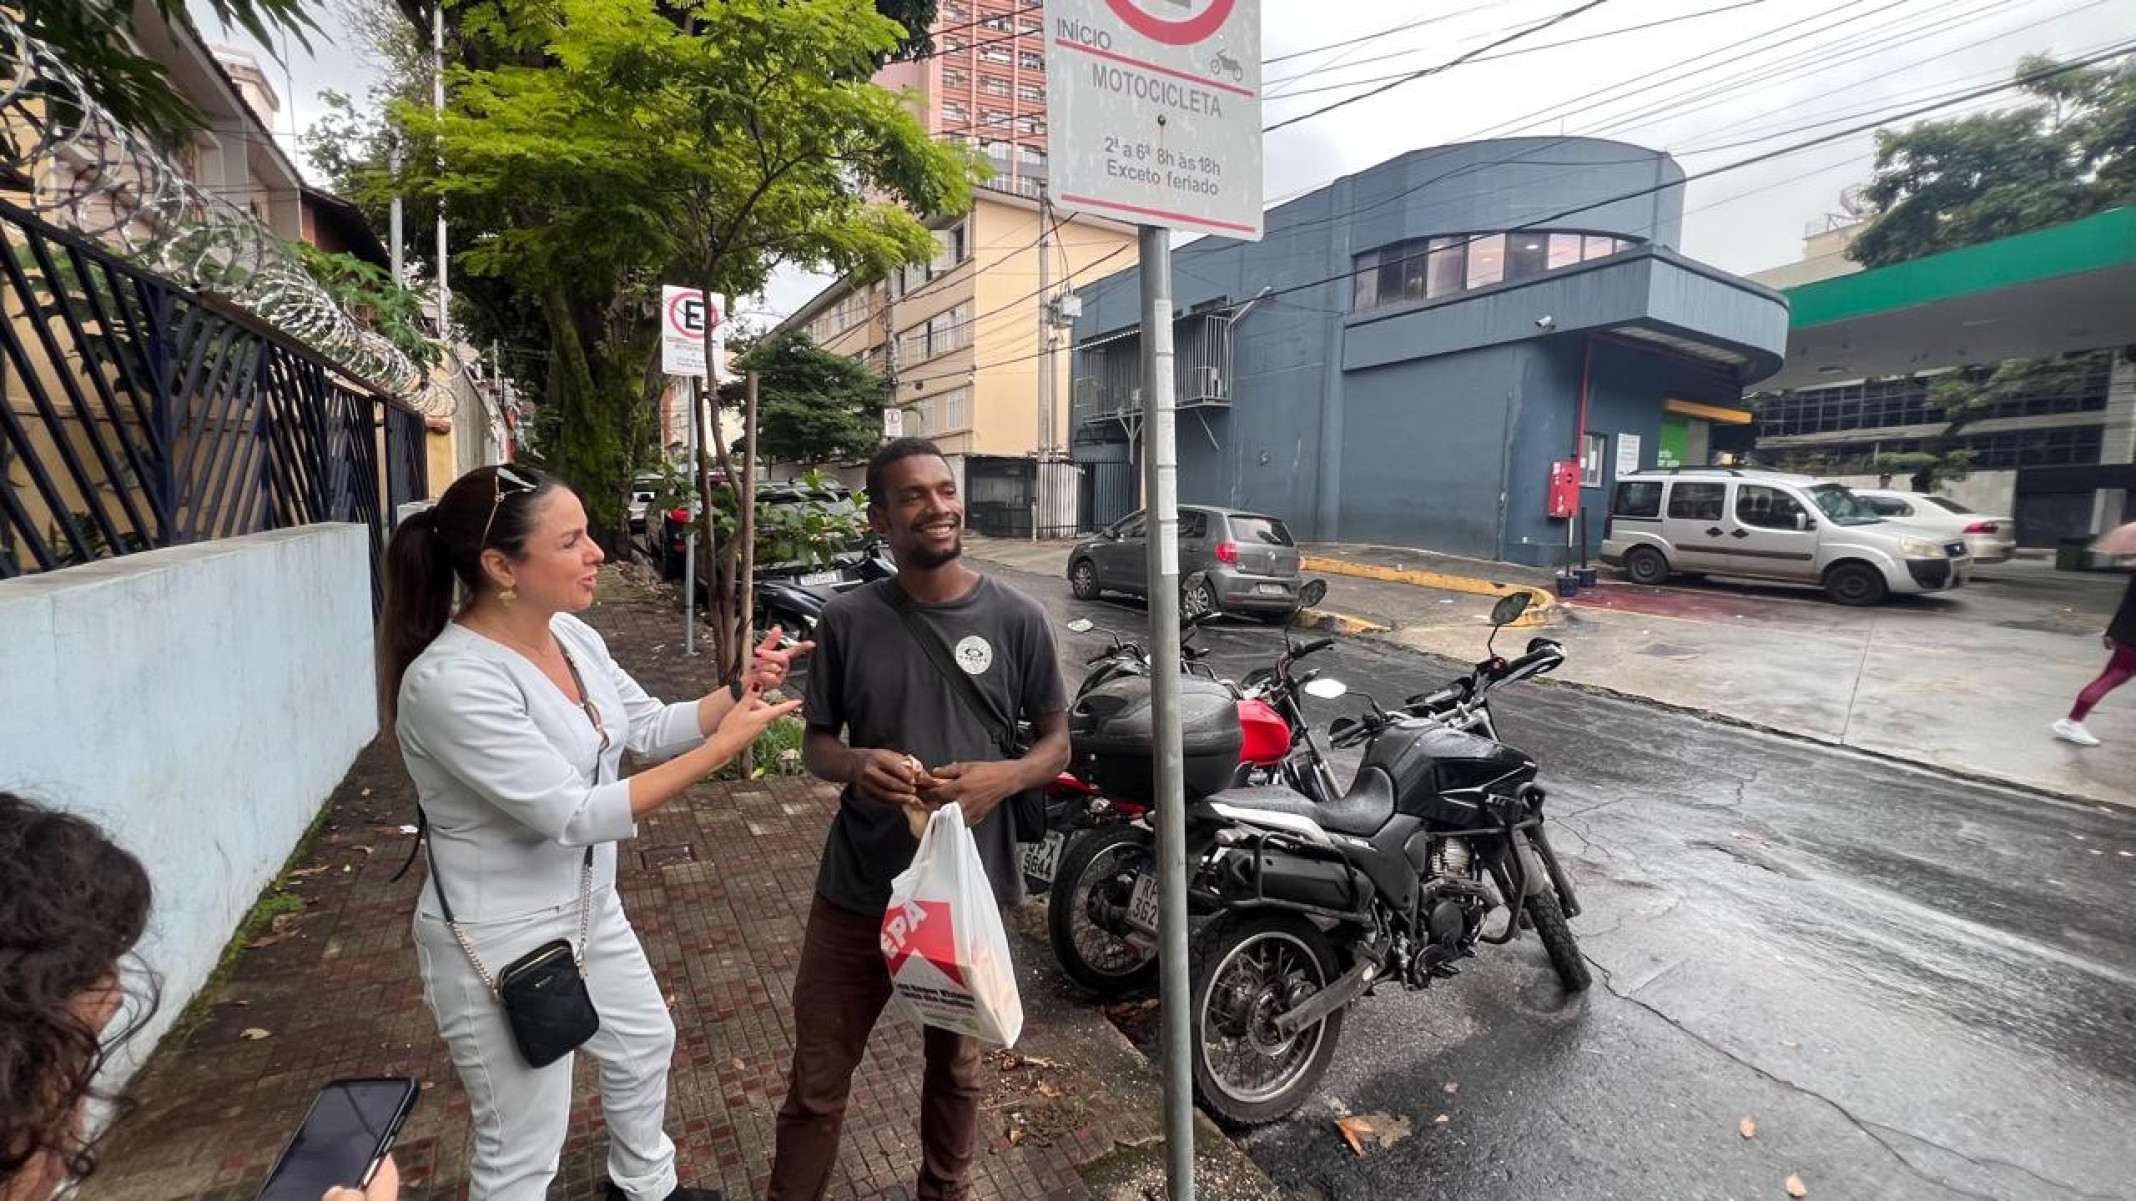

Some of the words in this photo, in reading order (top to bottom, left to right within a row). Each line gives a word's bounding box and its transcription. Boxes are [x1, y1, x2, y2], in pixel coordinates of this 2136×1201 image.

[1056, 17, 1112, 49] INÍCIO
[1092, 63, 1222, 118] MOTOCICLETA
[1122, 144, 1132, 158] a
[1157, 147, 1174, 166] 8h
[1197, 155, 1220, 176] 18h
[1107, 158, 1160, 185] Exceto
[1167, 170, 1219, 195] feriado
[685, 299, 704, 331] E
